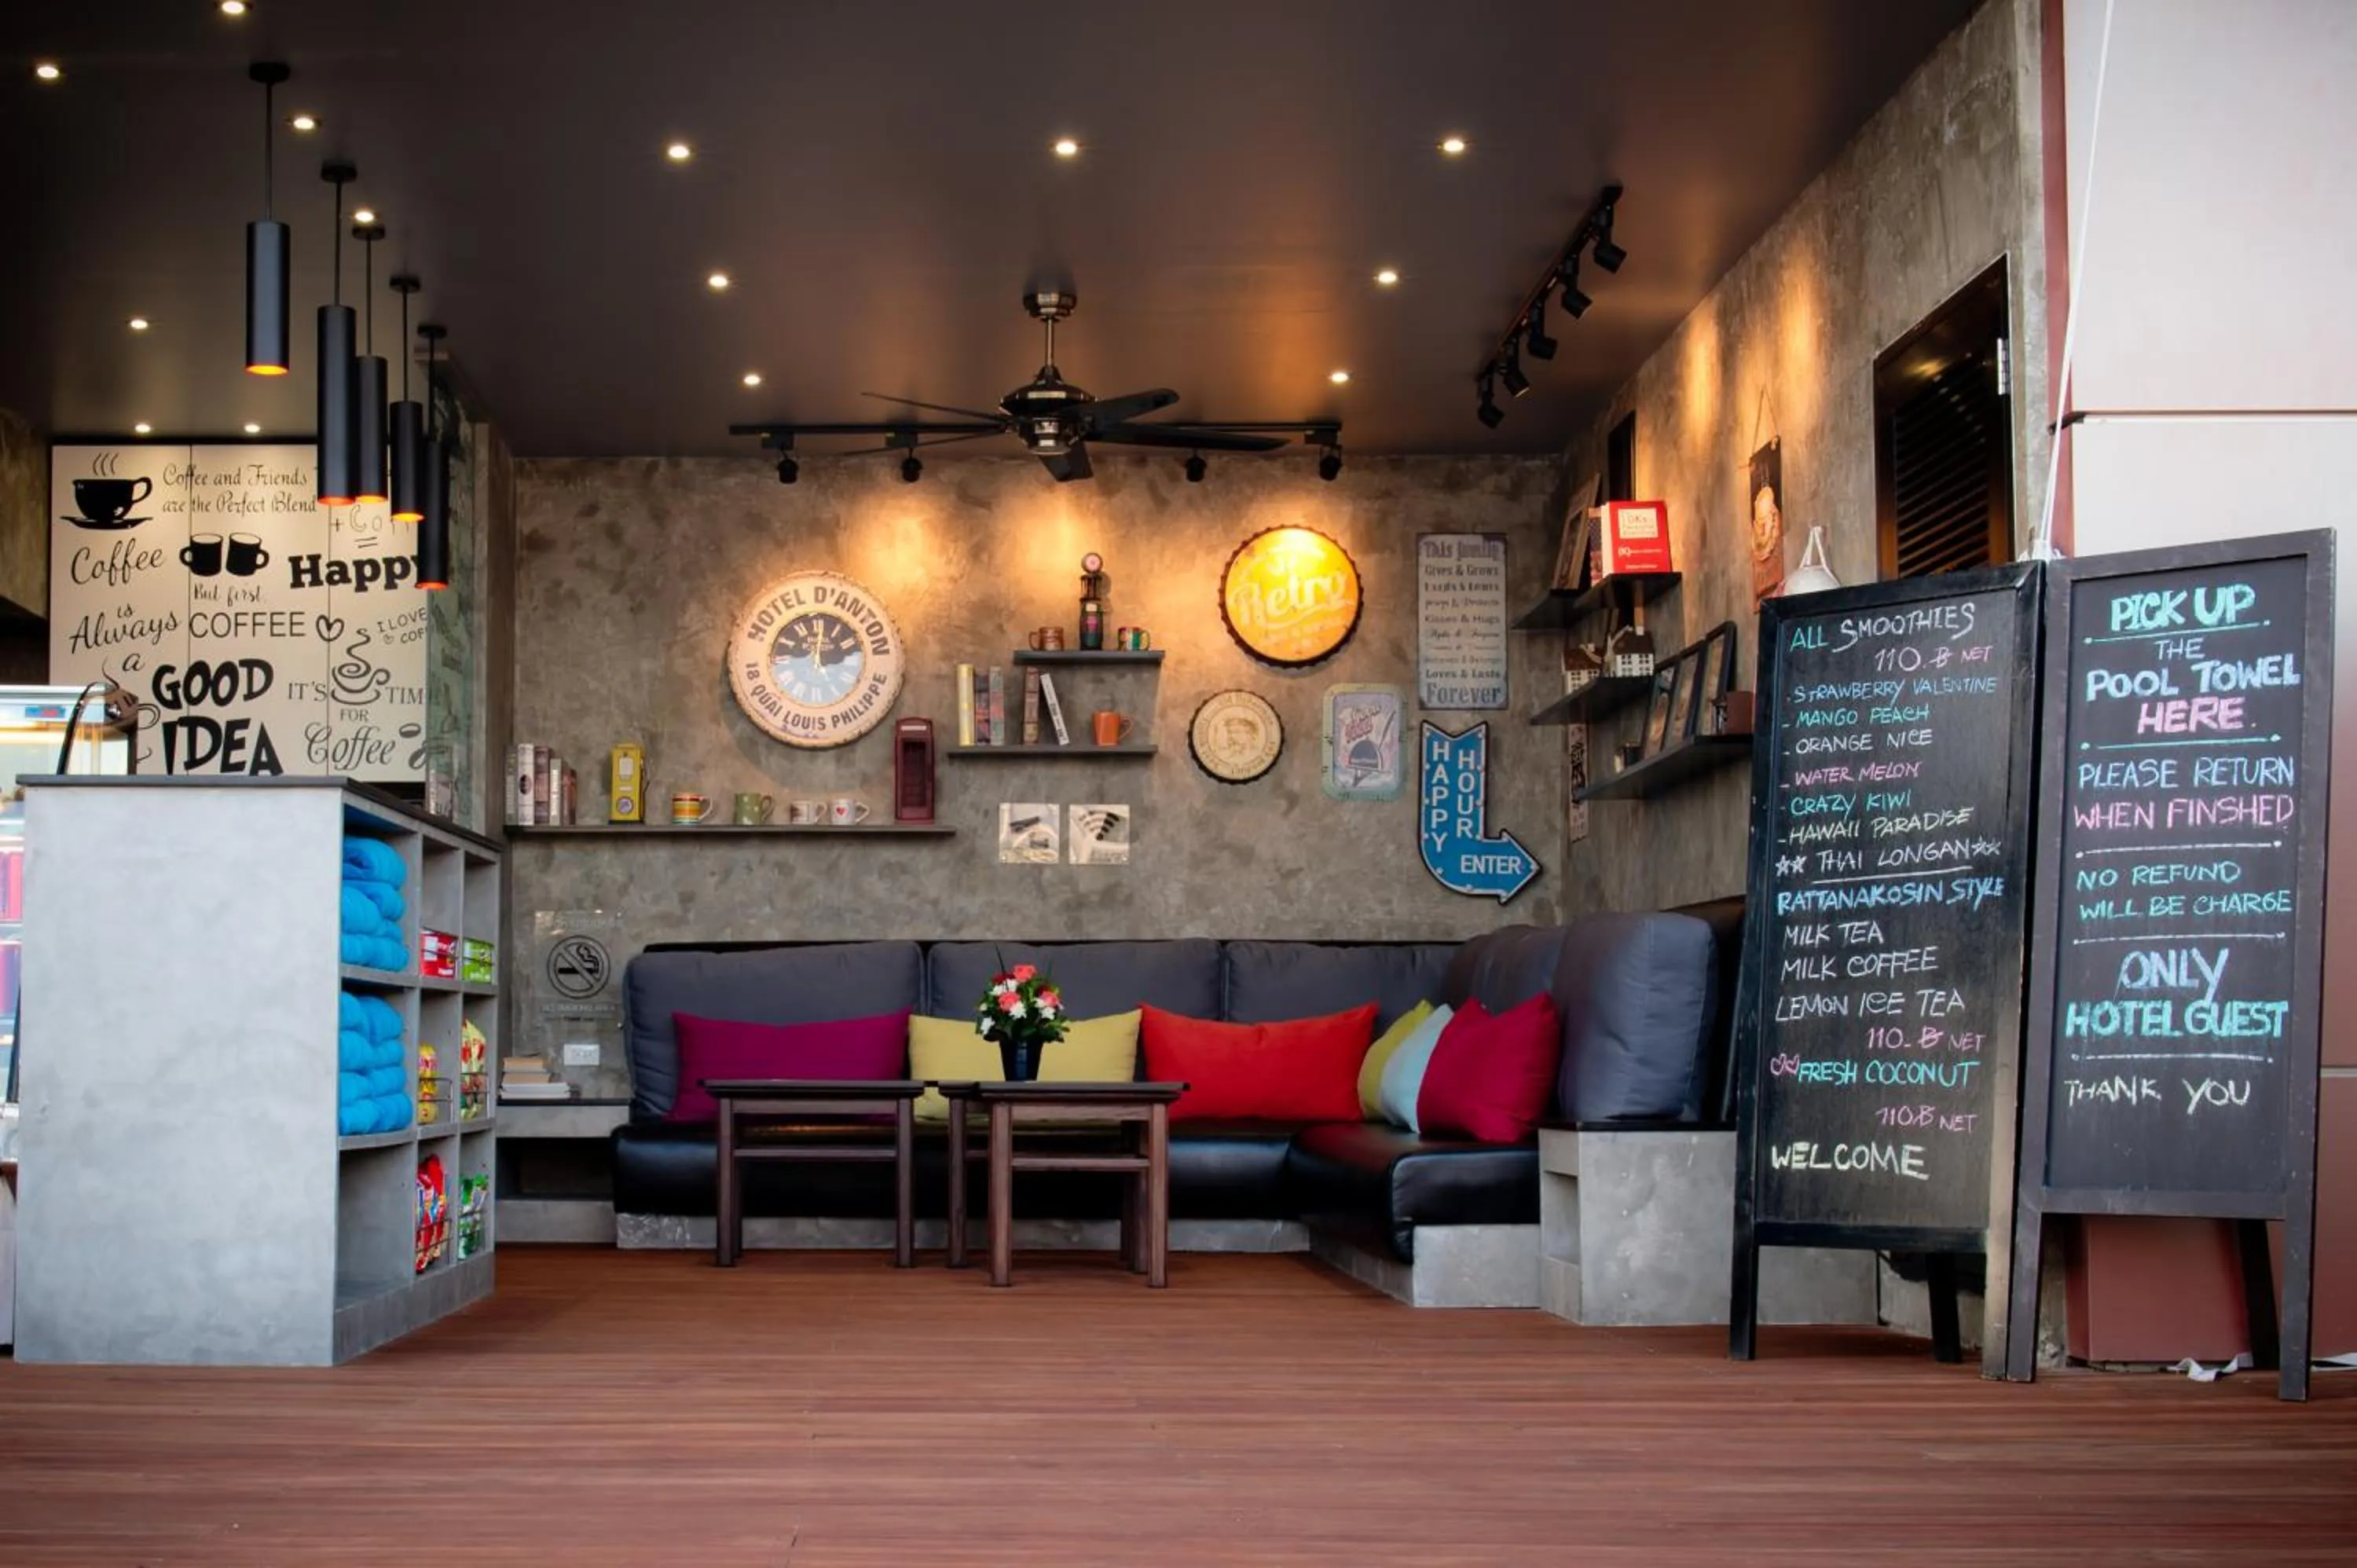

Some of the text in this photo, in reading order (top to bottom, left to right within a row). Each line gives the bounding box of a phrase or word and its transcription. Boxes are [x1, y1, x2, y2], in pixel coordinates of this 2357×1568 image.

[163, 463, 307, 490] Coffee and Friends
[163, 490, 317, 517] are the Perfect Blend
[71, 537, 164, 587] Coffee
[194, 583, 220, 602] But
[2111, 584, 2256, 631] PICK UP
[117, 603, 134, 619] is
[189, 611, 306, 639] COFFEE
[388, 607, 427, 631] LOVE
[747, 586, 890, 655] HOTEL D'ANTON
[69, 611, 181, 654] Always
[1789, 603, 1975, 653] ALL SMOOTHIES
[122, 653, 145, 672] a
[1961, 646, 1993, 663] NET
[2154, 638, 2205, 660] THE
[152, 658, 274, 710] GOOD
[288, 680, 328, 702] IT'S
[1794, 676, 1999, 705] STRAWBERRY VALENTINE
[2086, 653, 2301, 702] POOL TOWEL
[746, 662, 887, 731] 18 QUAI LOUIS PHILIPPE
[1427, 682, 1501, 705] Forever
[340, 709, 368, 721] FOR
[1796, 704, 1930, 728] MANGO PEACH
[162, 716, 284, 776] IDEA
[305, 722, 396, 771] Coffee
[1796, 729, 1933, 754] ORANGE NICE
[1795, 762, 1923, 786] WATER MELON
[2078, 756, 2294, 788] PLEASE RETURN
[1431, 741, 1450, 852] HAPPY
[1457, 749, 1475, 839] HOUR
[1791, 789, 1912, 819] CRAZY KIWI
[1789, 807, 1974, 845] HAWAII PARADISE
[2074, 802, 2155, 830] WHEN
[1461, 855, 1522, 874] ENTER
[1816, 839, 1970, 871] THAI LONGAN
[2076, 861, 2241, 892] NO REFUND
[1776, 877, 2005, 916] RATTANAKOSIN STYLE
[2080, 890, 2293, 919] WILL BE CHARGE
[1783, 921, 1883, 947] MILK TEA
[1780, 946, 1939, 984] MILK COFFEE
[2120, 947, 2229, 1002] ONLY
[1775, 988, 1965, 1022] LEMON ICE TEA
[2066, 1000, 2289, 1037] HOTEL GUEST
[1948, 1032, 1986, 1053] NET
[1798, 1061, 1980, 1088] FRESH COCONUT
[2064, 1075, 2251, 1115] THANK YOU
[1939, 1115, 1982, 1134] NET
[1771, 1141, 1930, 1181] WELCOME
